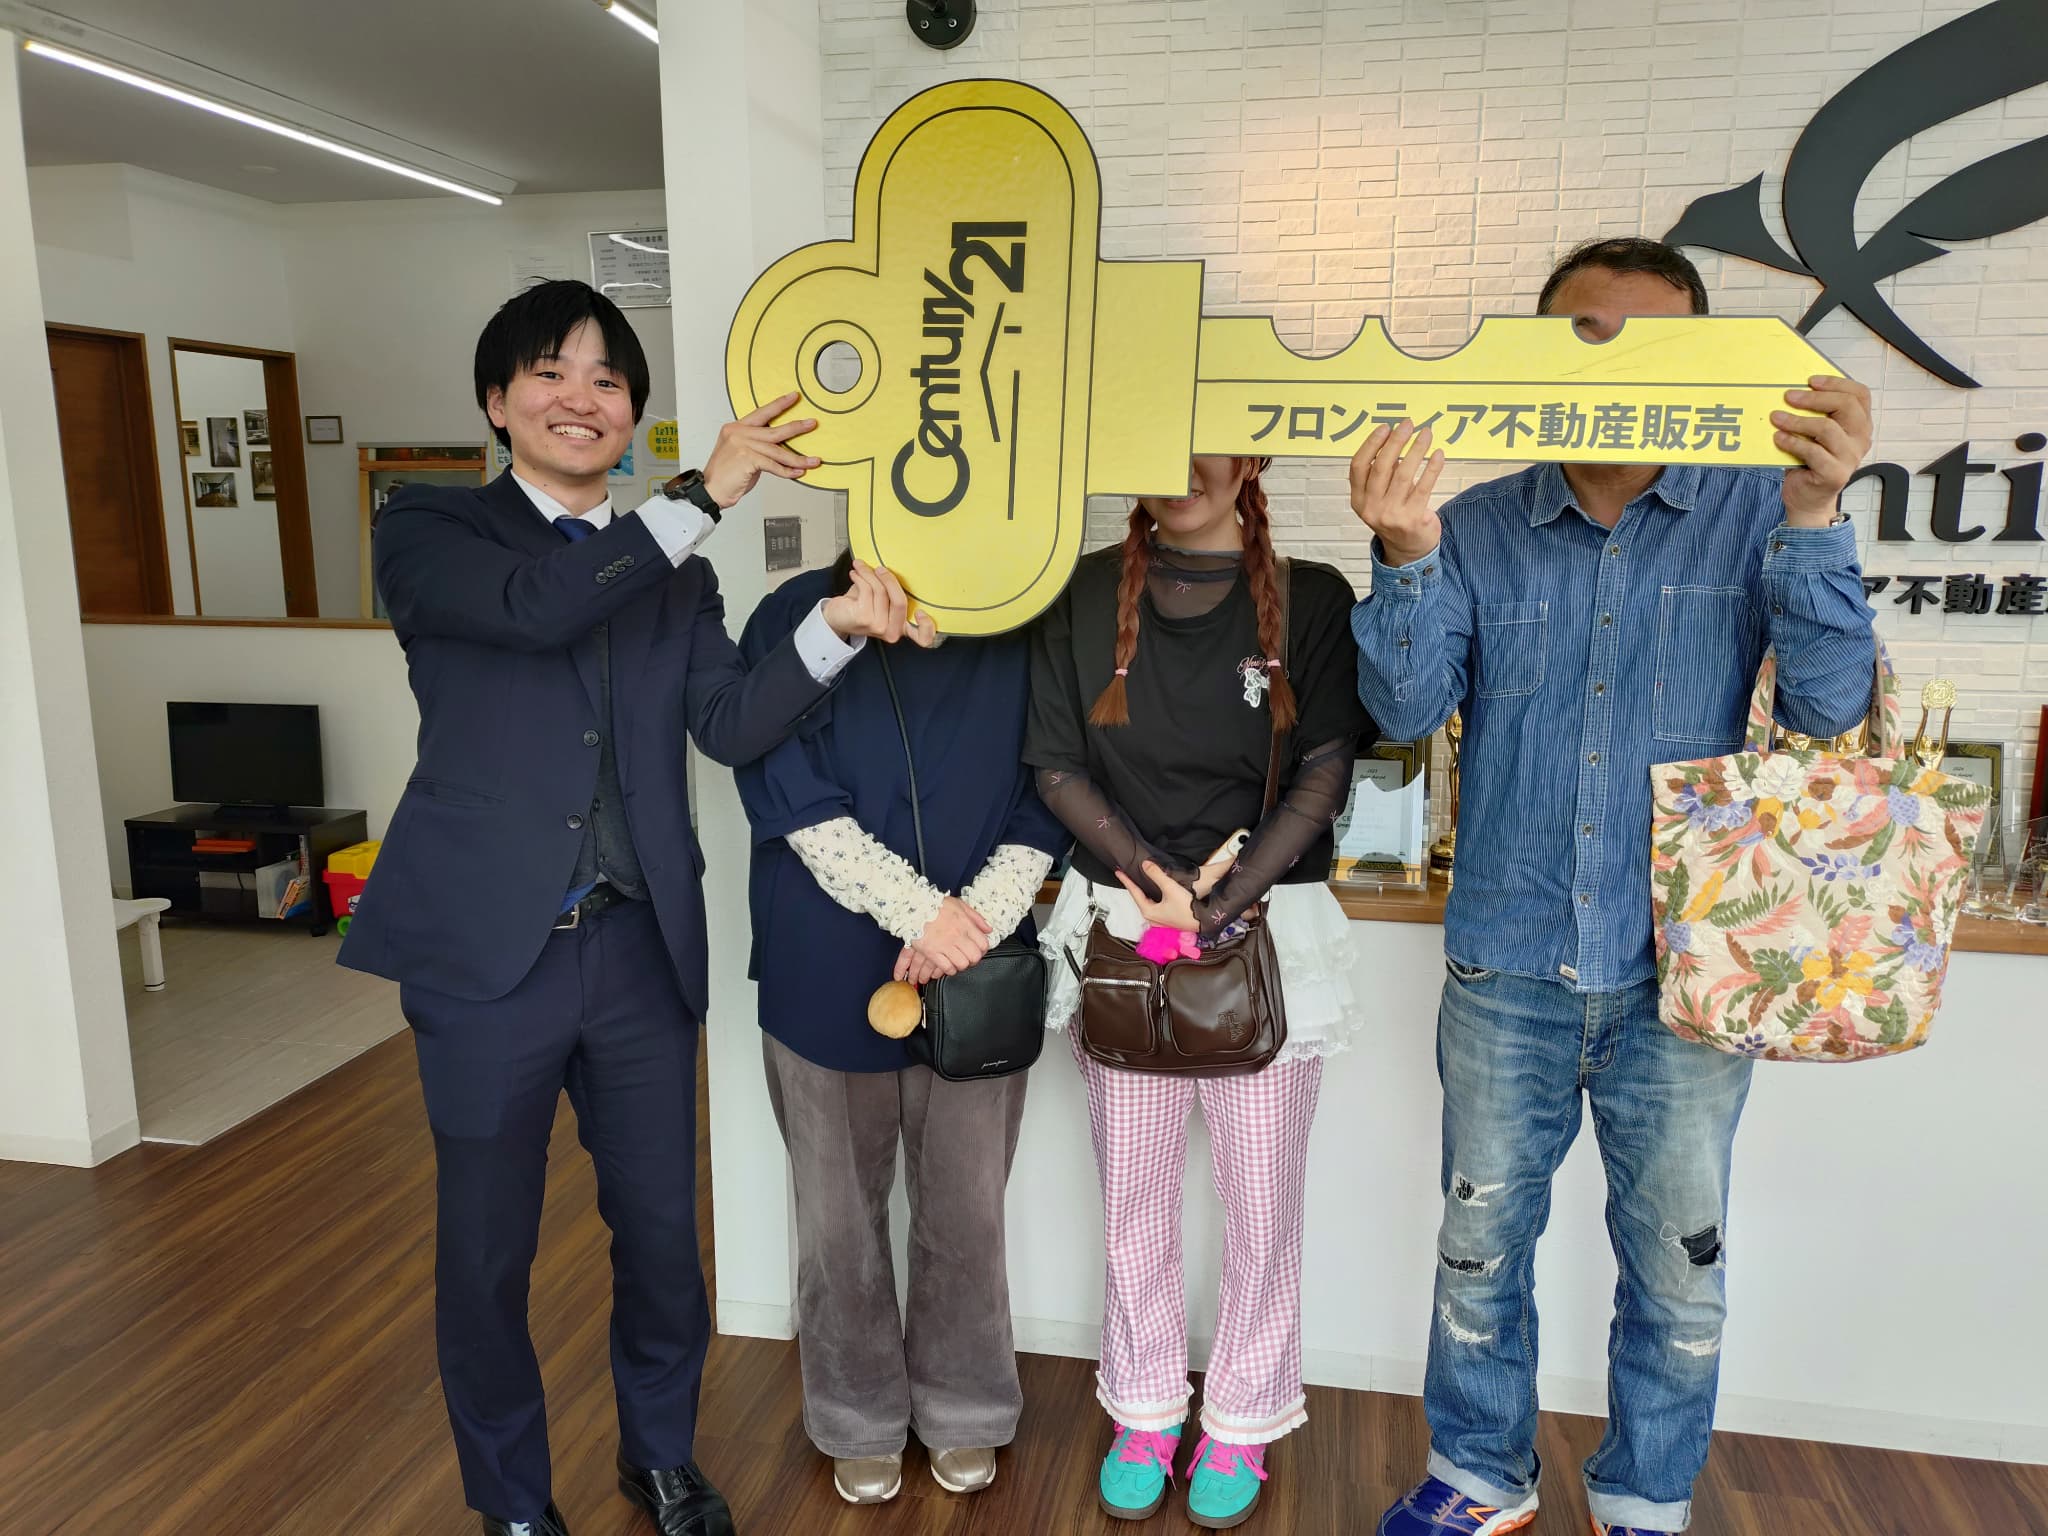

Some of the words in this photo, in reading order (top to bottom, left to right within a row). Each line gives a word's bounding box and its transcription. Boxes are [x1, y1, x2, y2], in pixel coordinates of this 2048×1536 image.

[890, 266, 975, 518] Century
[948, 220, 1028, 296] 21
[1247, 400, 1744, 452] フロンティア不動産販売
[1836, 432, 2047, 542] nti
